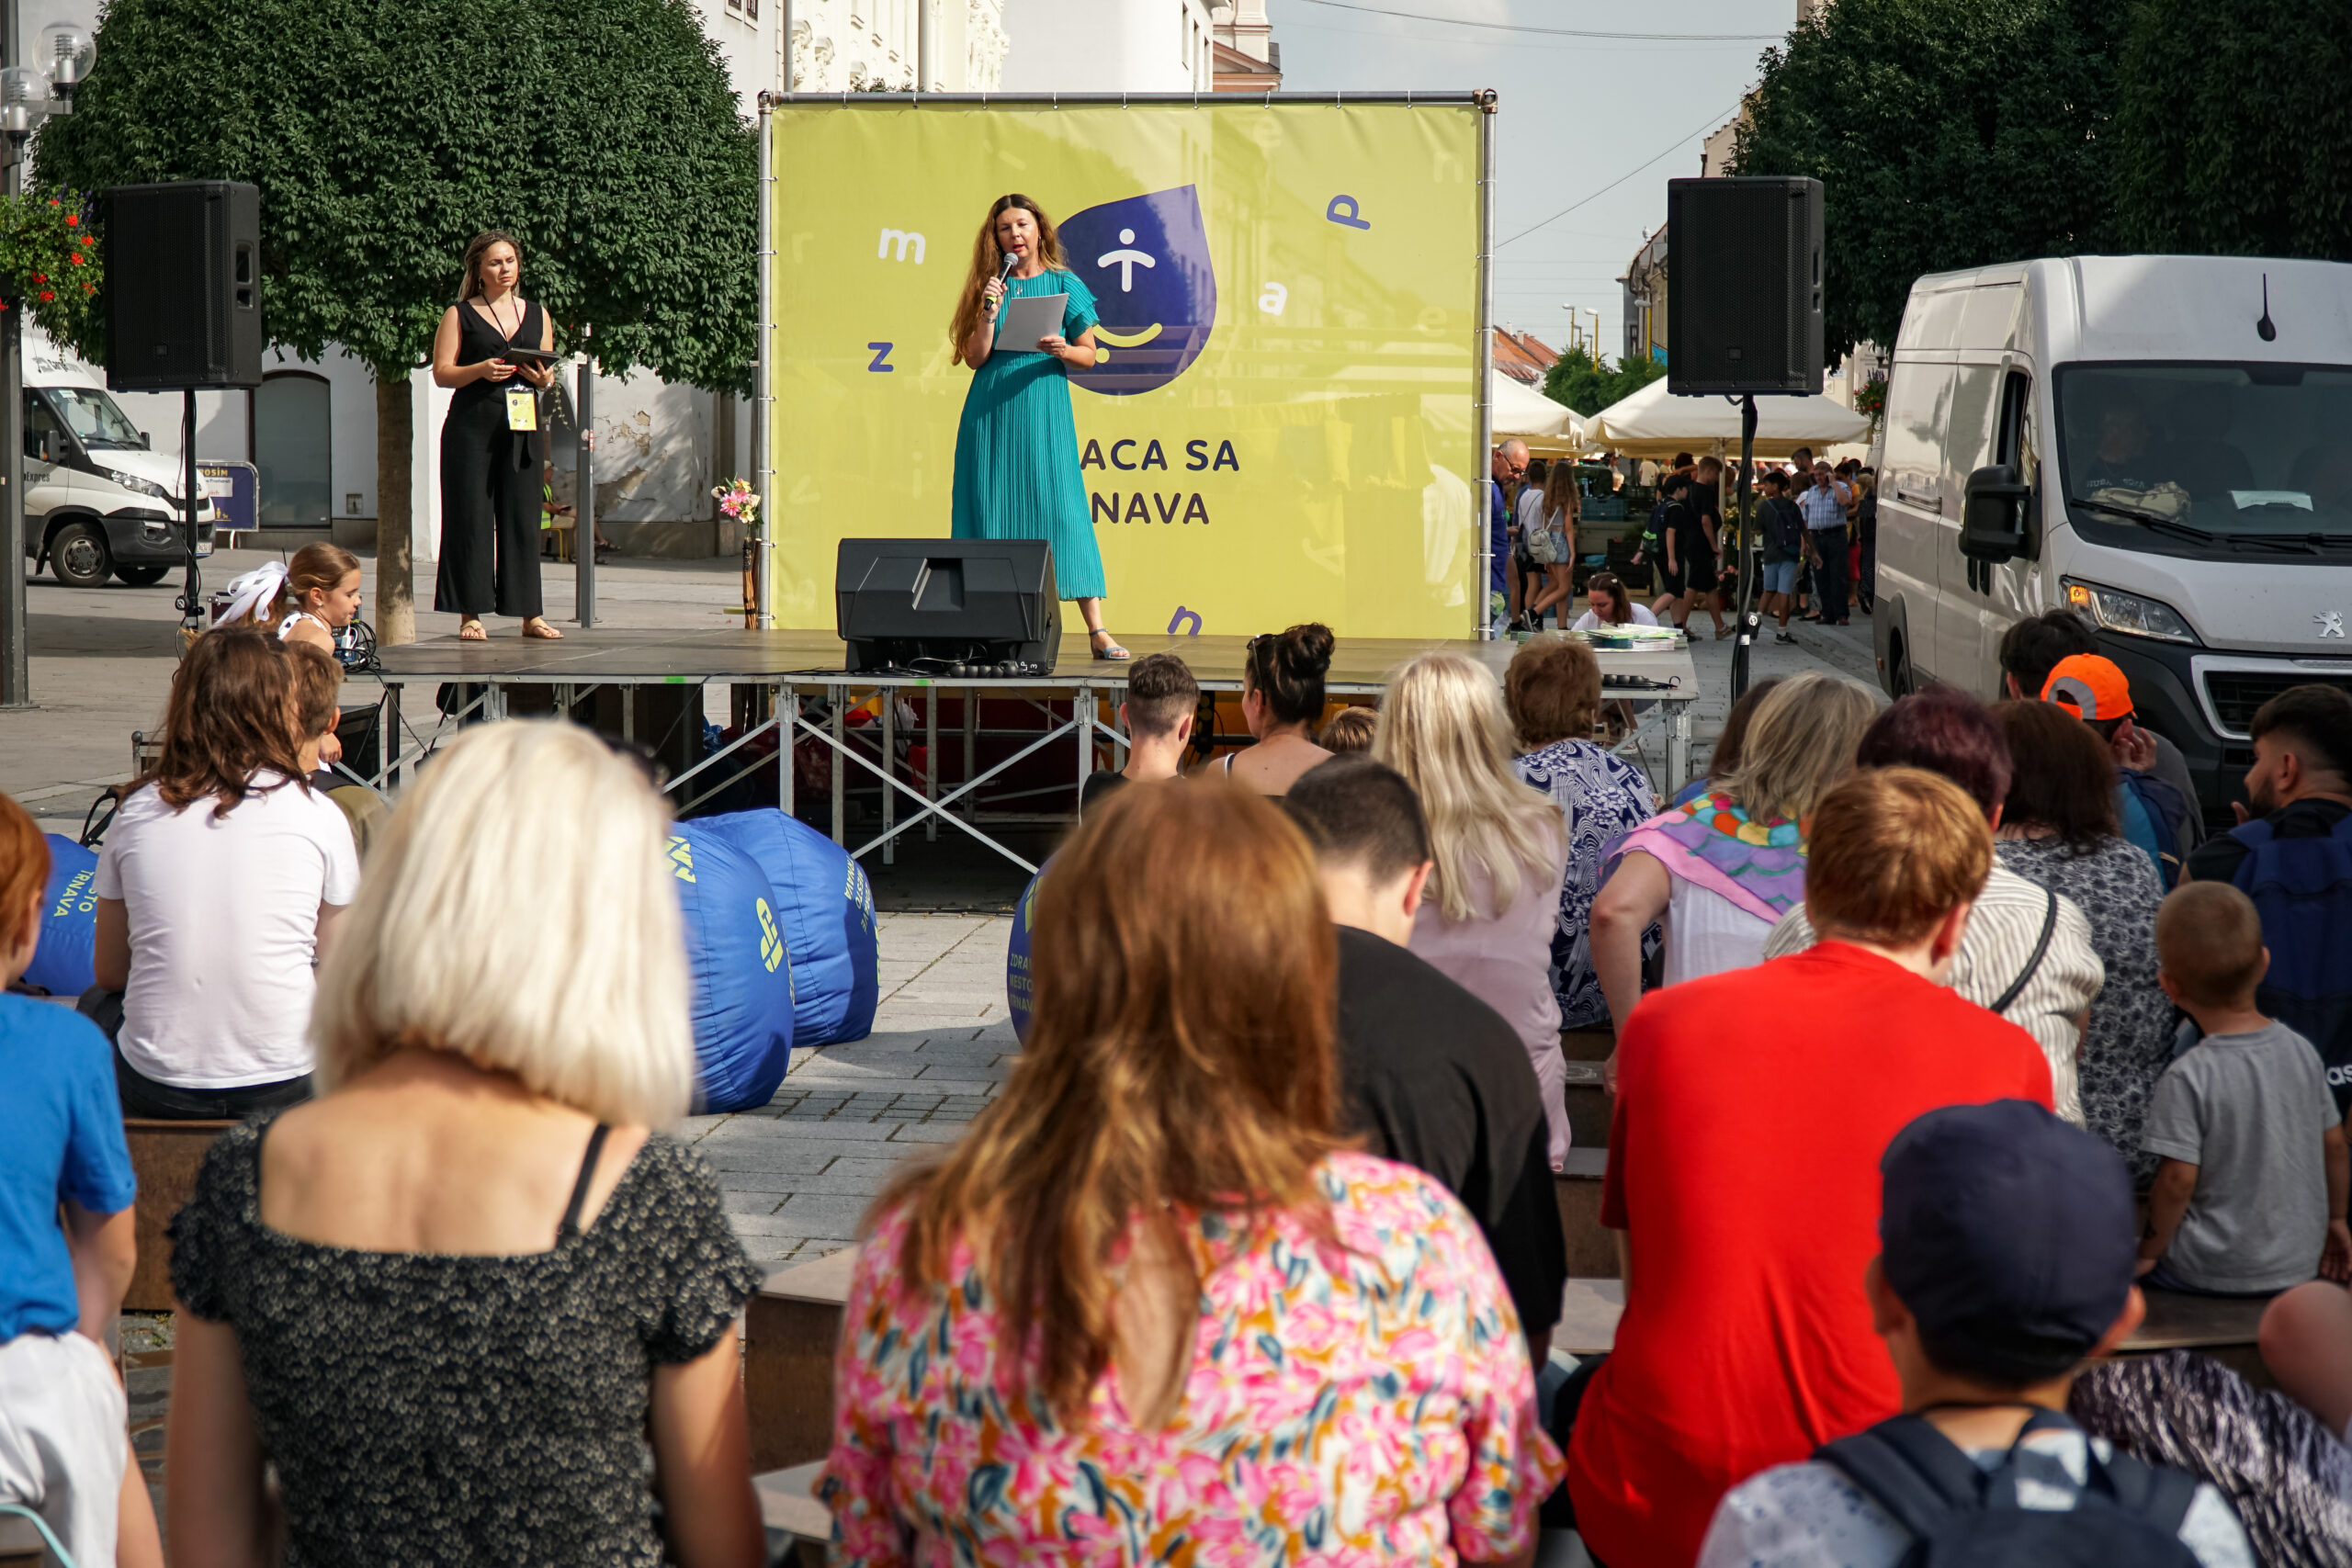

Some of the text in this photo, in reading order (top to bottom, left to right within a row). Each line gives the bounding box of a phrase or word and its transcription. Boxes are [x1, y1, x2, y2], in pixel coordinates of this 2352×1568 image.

[878, 227, 926, 265] m
[1258, 281, 1288, 316] a
[1080, 438, 1240, 471] ACA SA
[1091, 491, 1210, 525] NAVA
[53, 870, 96, 917] TRNAVA
